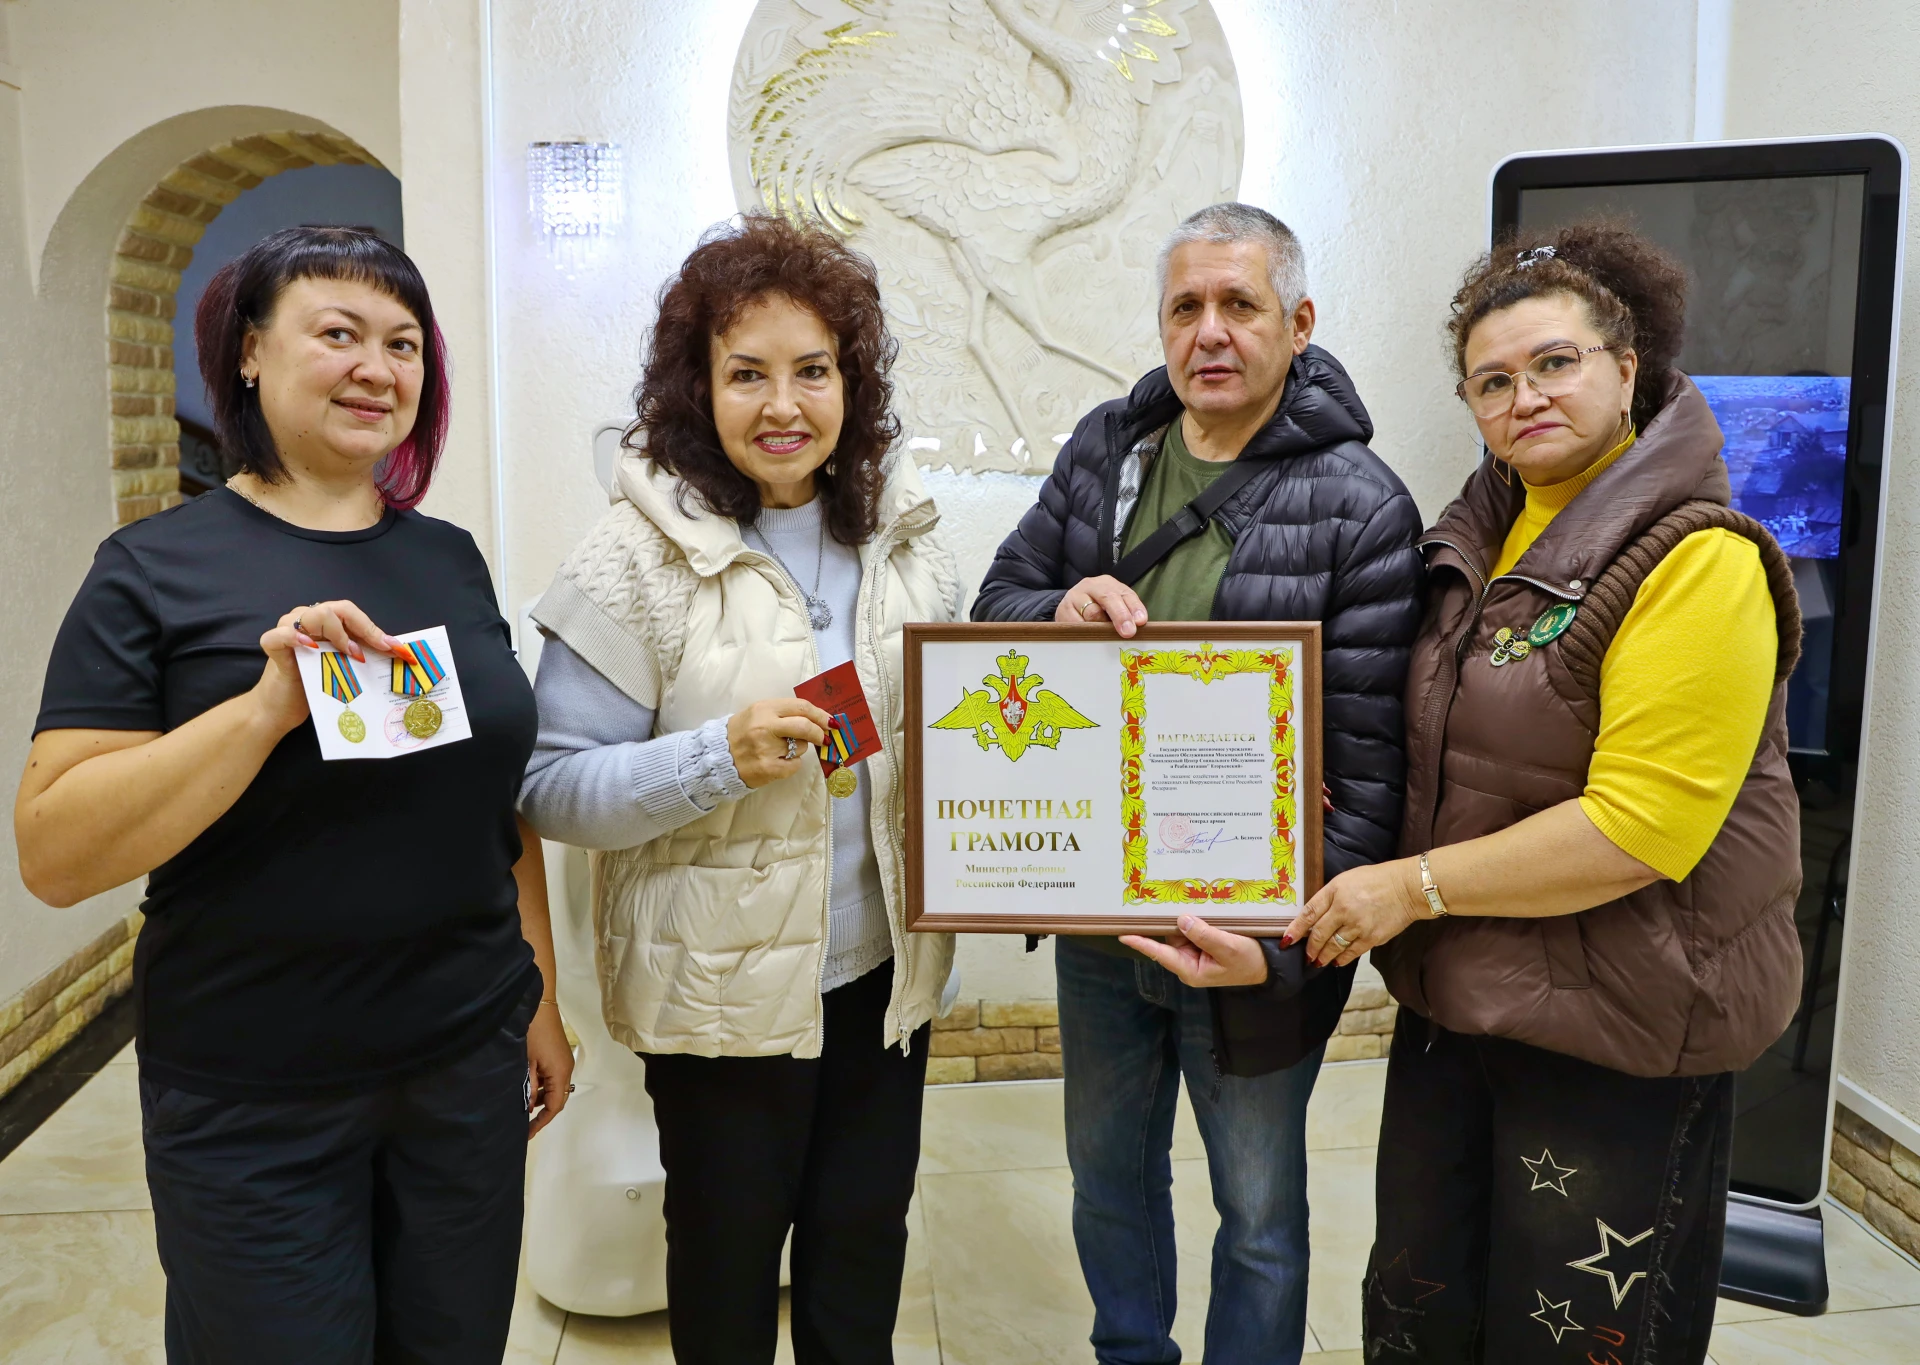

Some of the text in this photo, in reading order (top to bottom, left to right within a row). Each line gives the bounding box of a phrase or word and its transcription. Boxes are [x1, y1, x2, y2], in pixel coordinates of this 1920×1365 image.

[1157, 733, 1256, 743] НАГРАЖДАЕТСЯ
[937, 799, 1093, 820] ПОЧЕТНАЯ
[950, 831, 1081, 852] ГРАМОТА
[965, 864, 1066, 875] Министра обороны
[955, 878, 1076, 890] Российской Федерации
